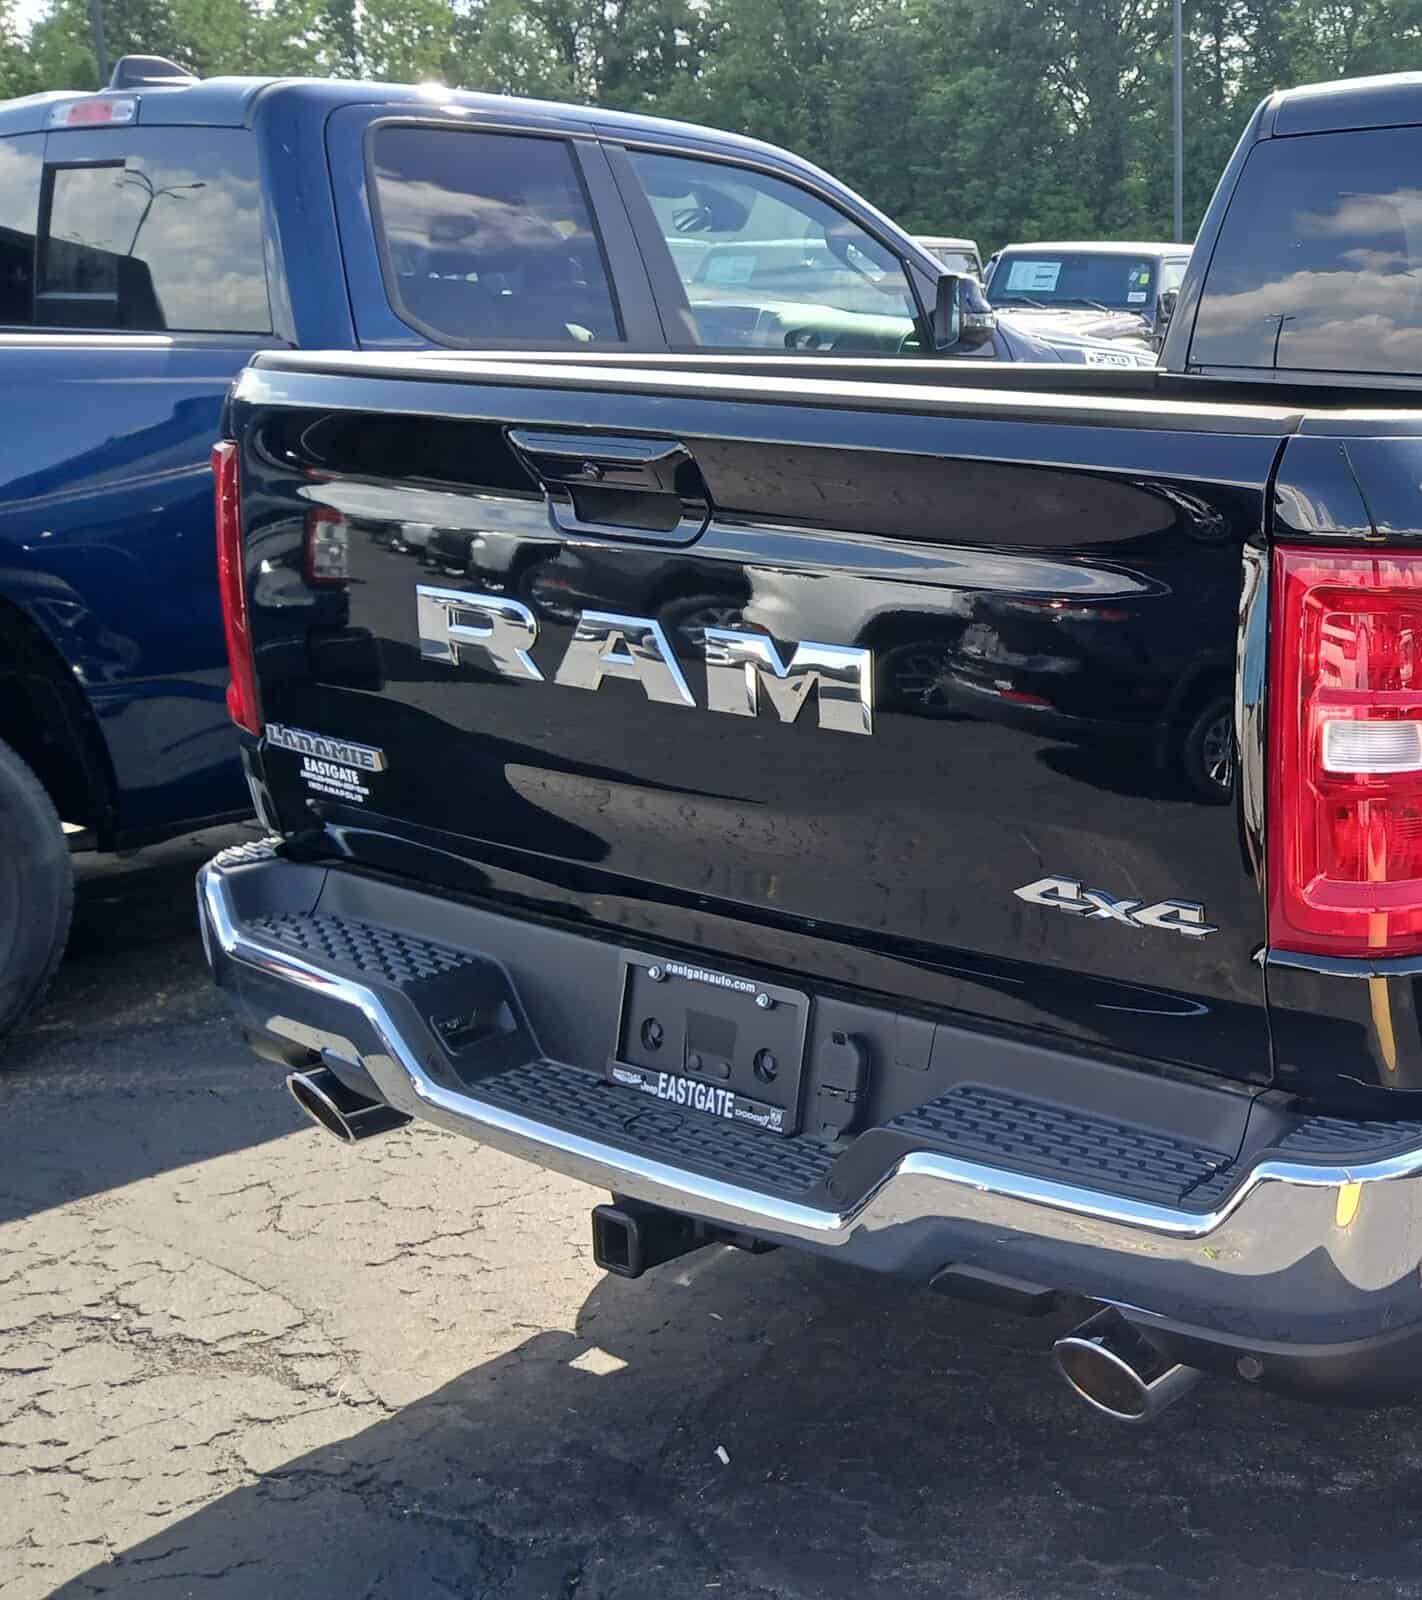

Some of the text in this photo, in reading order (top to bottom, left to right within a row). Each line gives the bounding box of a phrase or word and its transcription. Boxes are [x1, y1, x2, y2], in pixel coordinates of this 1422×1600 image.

[416, 584, 873, 736] RAM
[265, 723, 379, 771] LARAMIE
[303, 756, 360, 784] EASTGATE
[665, 962, 757, 993] eastgateauto.com
[656, 1072, 736, 1119] EASTGATE
